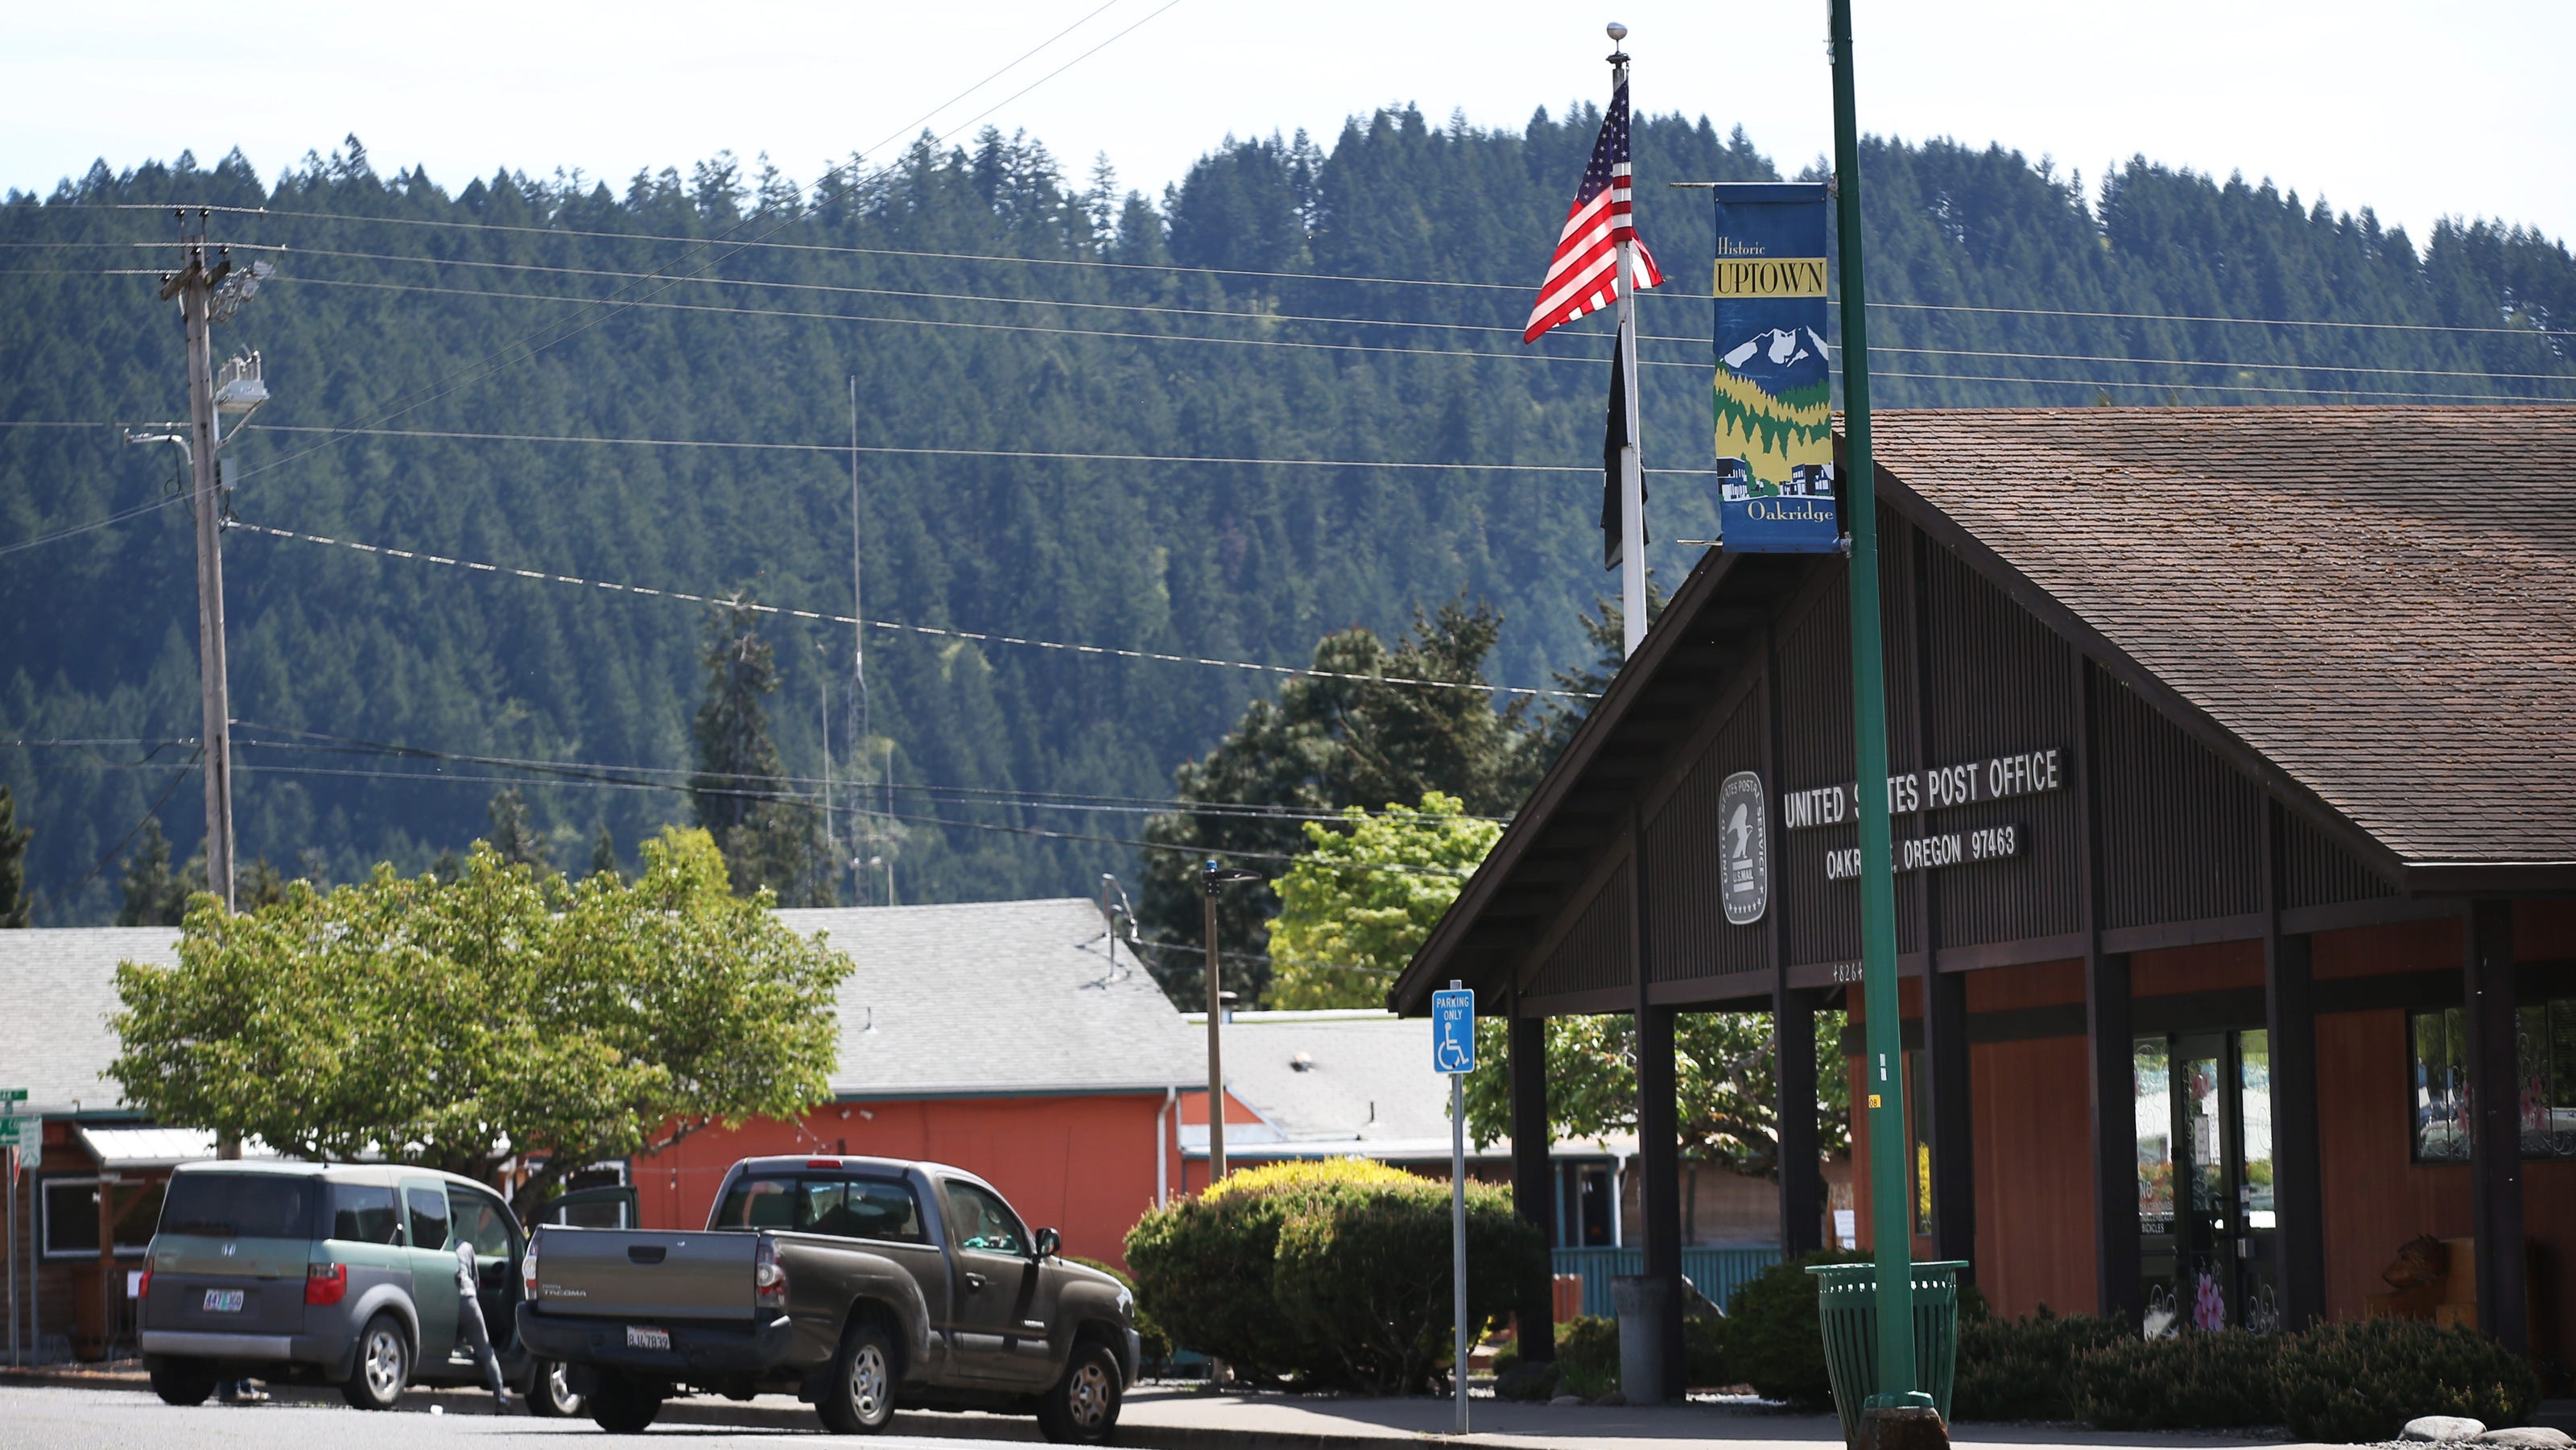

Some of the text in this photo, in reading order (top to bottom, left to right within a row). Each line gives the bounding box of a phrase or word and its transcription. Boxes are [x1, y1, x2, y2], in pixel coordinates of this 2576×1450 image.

[1718, 237, 1765, 255] Historic
[1717, 262, 1823, 294] UPTOWN
[1748, 500, 1834, 523] Oakridge
[1784, 750, 2058, 828] UNITED TES POST OFFICE
[1738, 779, 1761, 804] POSTAL
[1757, 806, 1765, 877] SERVICE
[1904, 834, 1962, 870] OREGON
[1971, 826, 2014, 859] 97463
[1436, 997, 1469, 1009] PARKING
[1443, 1010, 1463, 1021] ONLY
[2139, 1181, 2153, 1199] NO
[542, 1288, 587, 1297] TACOMA
